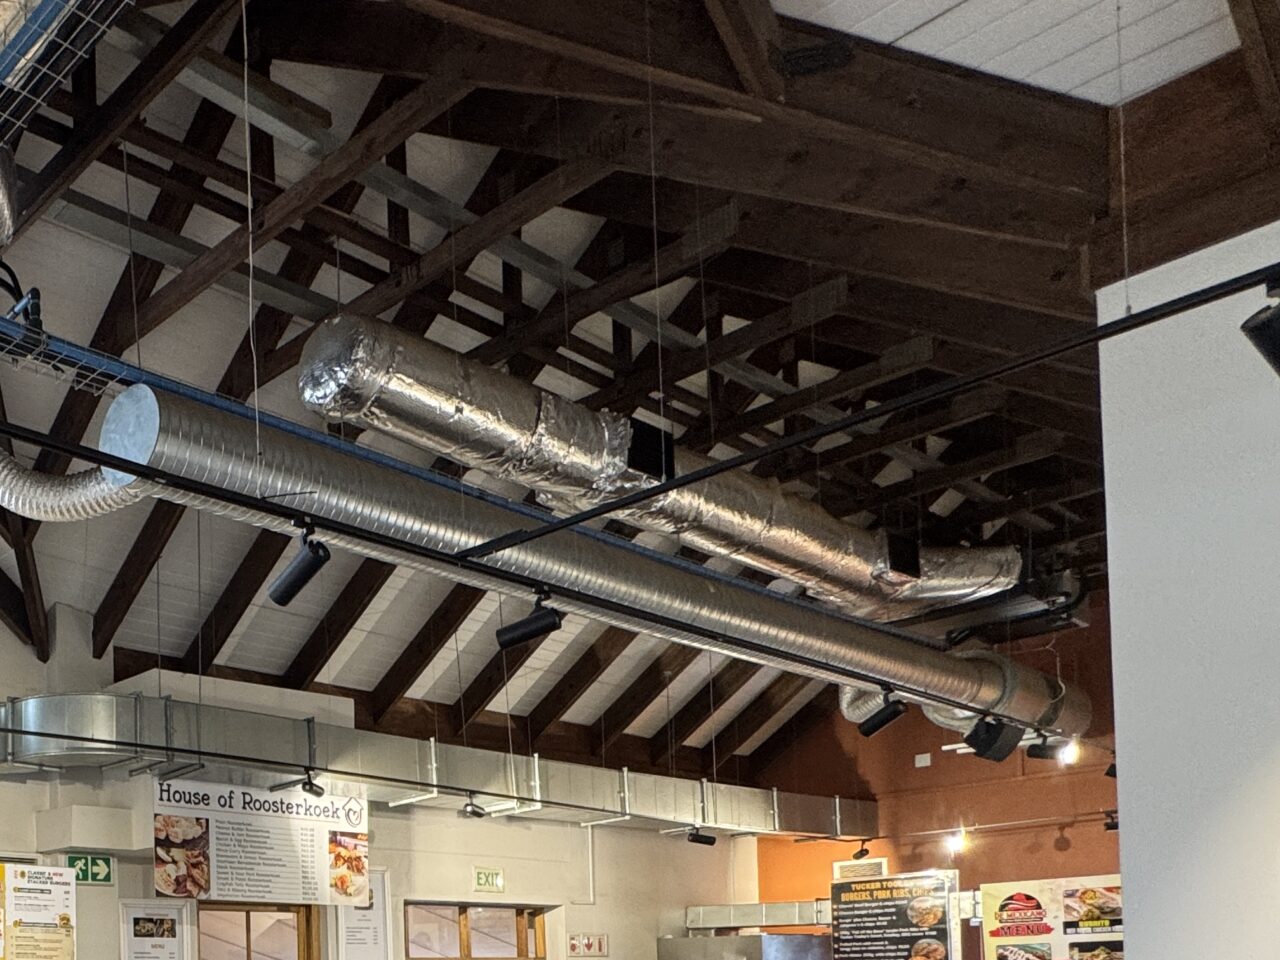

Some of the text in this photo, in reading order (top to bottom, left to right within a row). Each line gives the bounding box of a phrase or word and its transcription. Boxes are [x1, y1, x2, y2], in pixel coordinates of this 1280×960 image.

[158, 782, 341, 819] House of Roosterkoek
[476, 871, 500, 886] EXIT
[851, 882, 881, 891] TUCKER
[841, 891, 873, 902] BURGERS,
[873, 889, 892, 900] PORK
[892, 888, 911, 899] RIBS,
[999, 924, 1046, 936] MENU
